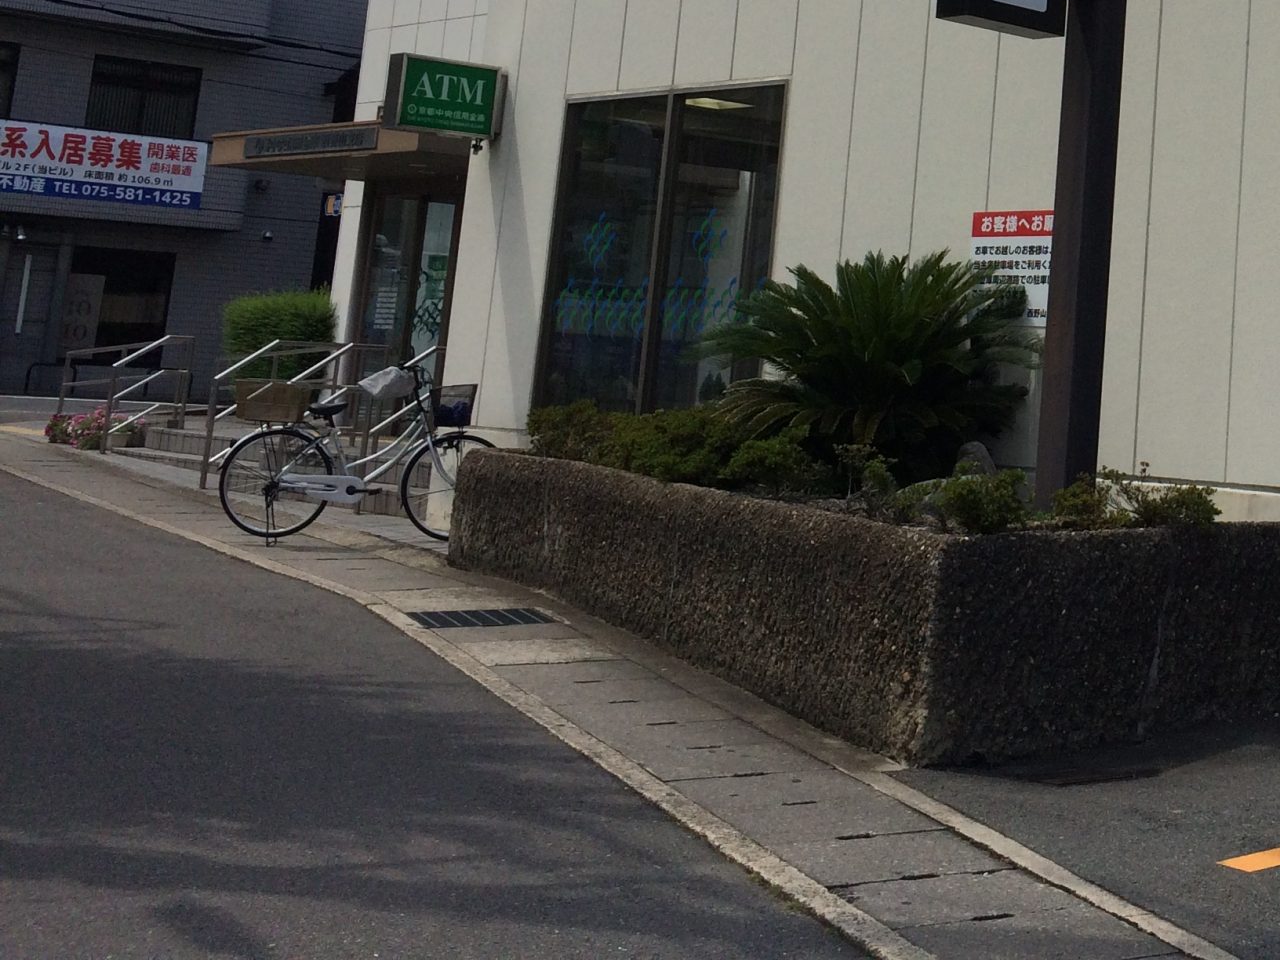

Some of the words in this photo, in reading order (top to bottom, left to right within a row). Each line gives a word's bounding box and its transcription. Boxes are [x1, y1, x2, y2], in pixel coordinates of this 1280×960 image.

[411, 71, 487, 106] ATM
[0, 126, 143, 171] 系入居募集
[147, 142, 198, 163] 開業医
[84, 170, 115, 182] 床面積
[54, 181, 78, 195] TEL
[82, 184, 191, 206] 075-581-1425
